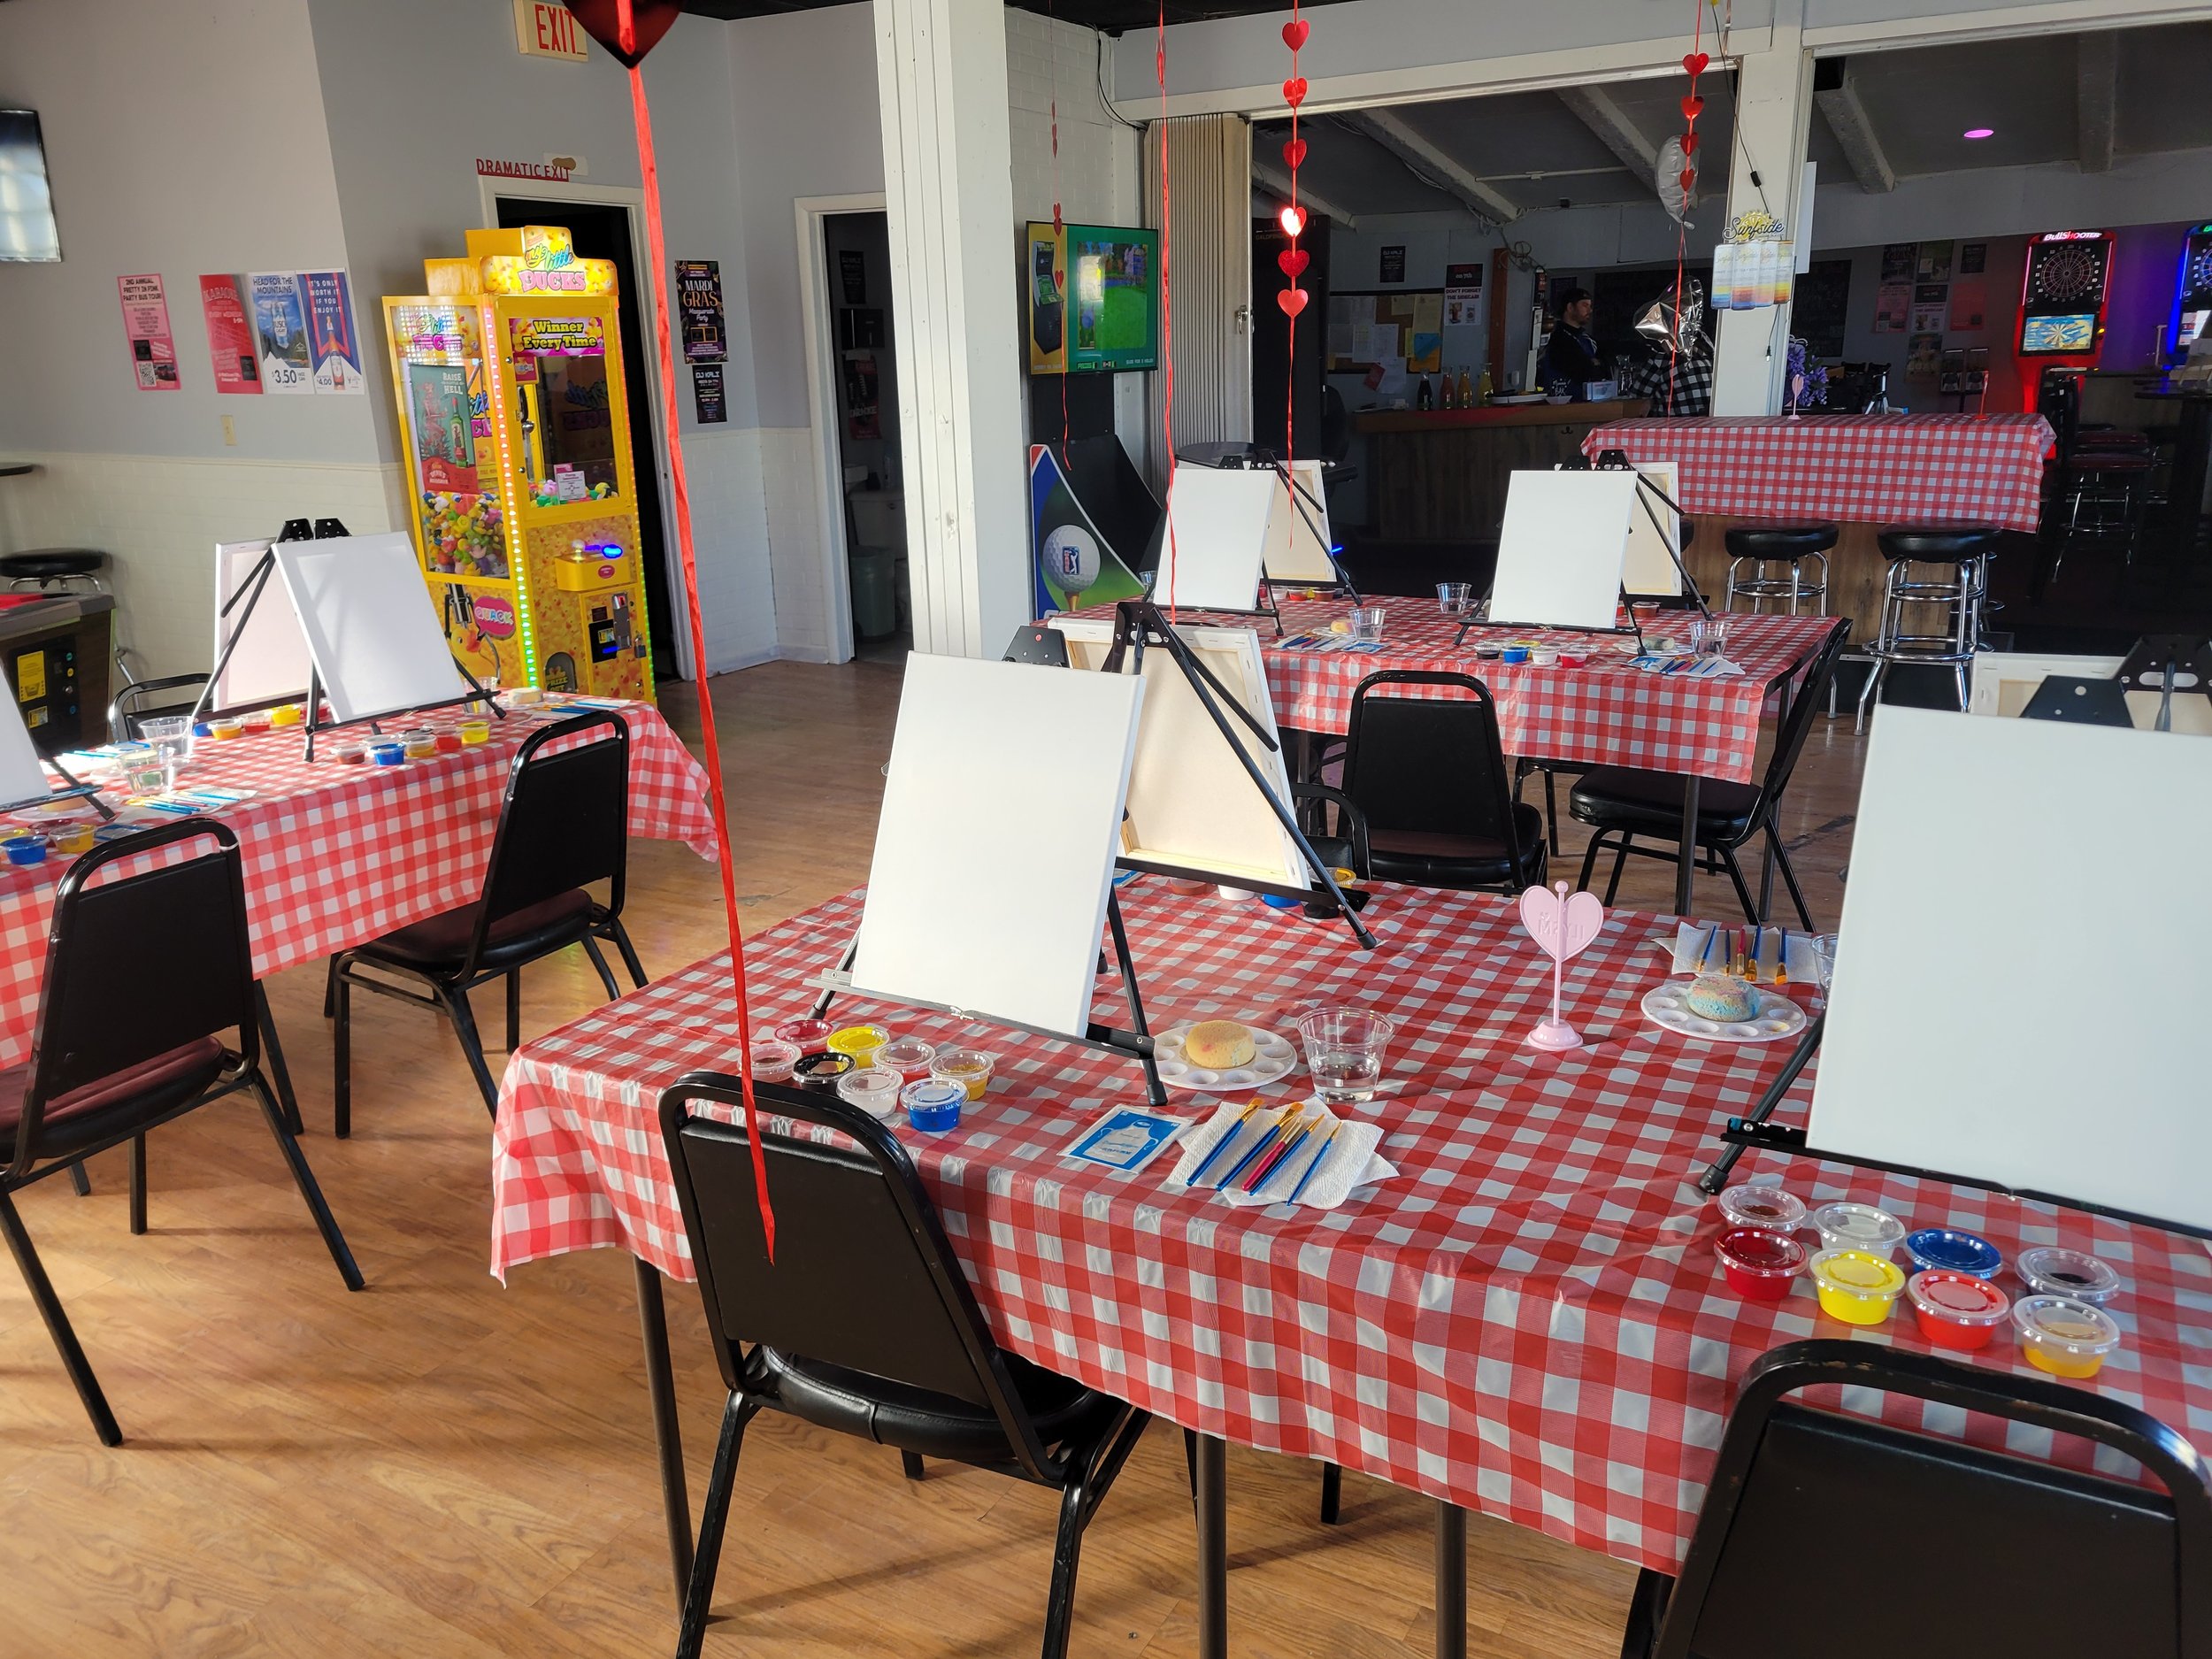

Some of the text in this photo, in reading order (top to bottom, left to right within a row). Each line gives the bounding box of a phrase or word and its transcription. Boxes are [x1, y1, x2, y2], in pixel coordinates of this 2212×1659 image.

[534, 4, 577, 54] EXIT
[476, 158, 571, 181] DRAMATIC EXIT
[1723, 217, 1785, 240] Surfside
[544, 243, 574, 272] little
[518, 269, 586, 293] DUCKS
[685, 280, 713, 291] MARDI
[683, 291, 718, 307] GRAS
[533, 320, 584, 334] Winner
[522, 335, 597, 351] Every Time
[442, 372, 462, 381] RAISE
[443, 385, 463, 395] HELL
[474, 606, 514, 625] QUACK
[547, 677, 568, 687] PRIZE
